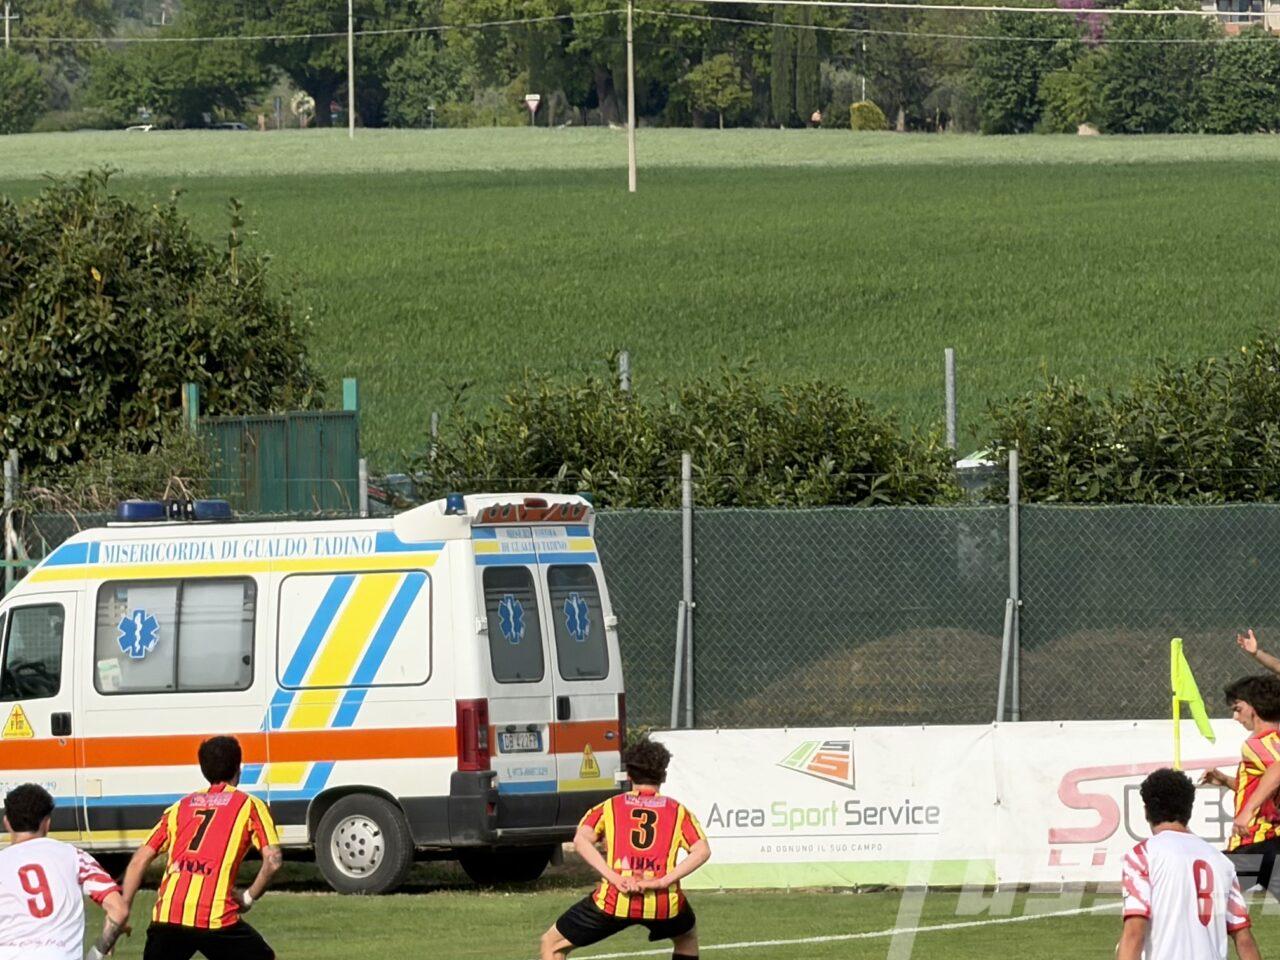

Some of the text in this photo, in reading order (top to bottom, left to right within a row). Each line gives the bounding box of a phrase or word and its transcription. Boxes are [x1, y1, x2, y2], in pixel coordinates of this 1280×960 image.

[102, 535, 373, 563] MISERICORDIA DI GUALDO TADINO
[187, 806, 219, 853] 7
[630, 807, 659, 852] 3
[706, 799, 940, 831] Area Sport Service
[760, 845, 772, 853] AD
[817, 844, 826, 852] IL
[830, 844, 848, 852] SUO
[850, 843, 883, 852] CAMPO
[17, 863, 55, 919] 9
[1192, 858, 1214, 927] 8
